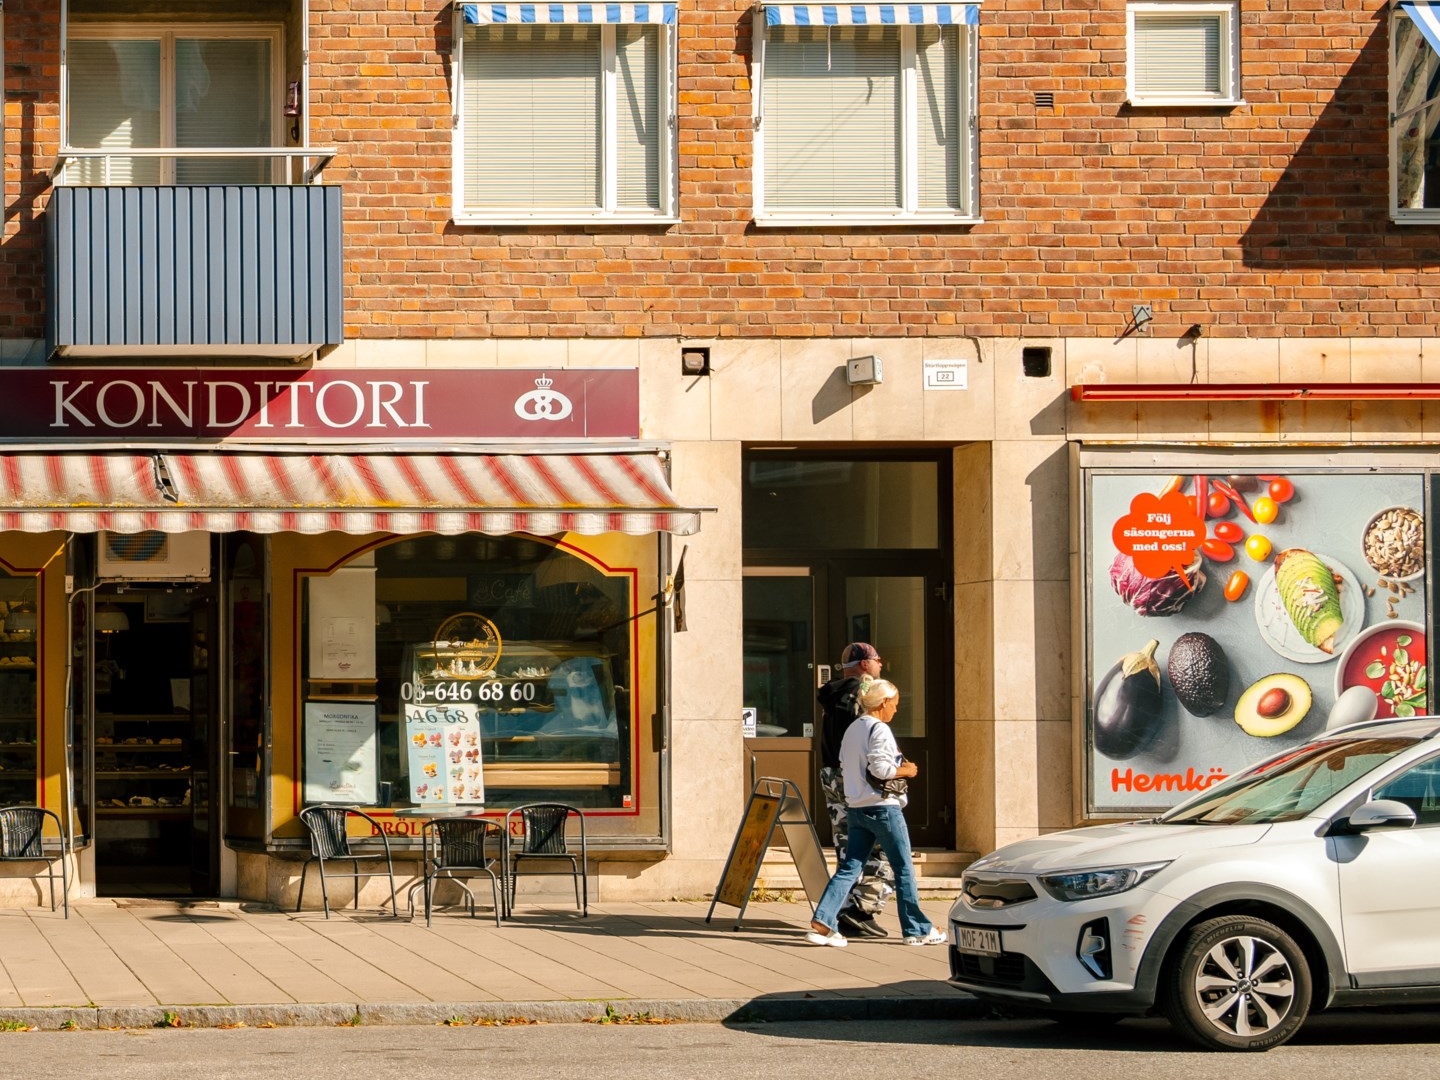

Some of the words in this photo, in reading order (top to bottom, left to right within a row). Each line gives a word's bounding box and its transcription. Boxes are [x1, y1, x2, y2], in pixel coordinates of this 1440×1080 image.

[49, 379, 432, 429] KONDITORI
[1146, 513, 1171, 525] Följ
[1123, 527, 1196, 540] säsongerna
[1132, 542, 1159, 551] med
[1161, 541, 1187, 551] oss!
[478, 681, 504, 701] 68
[510, 682, 535, 701] 60
[978, 931, 997, 951] 21M
